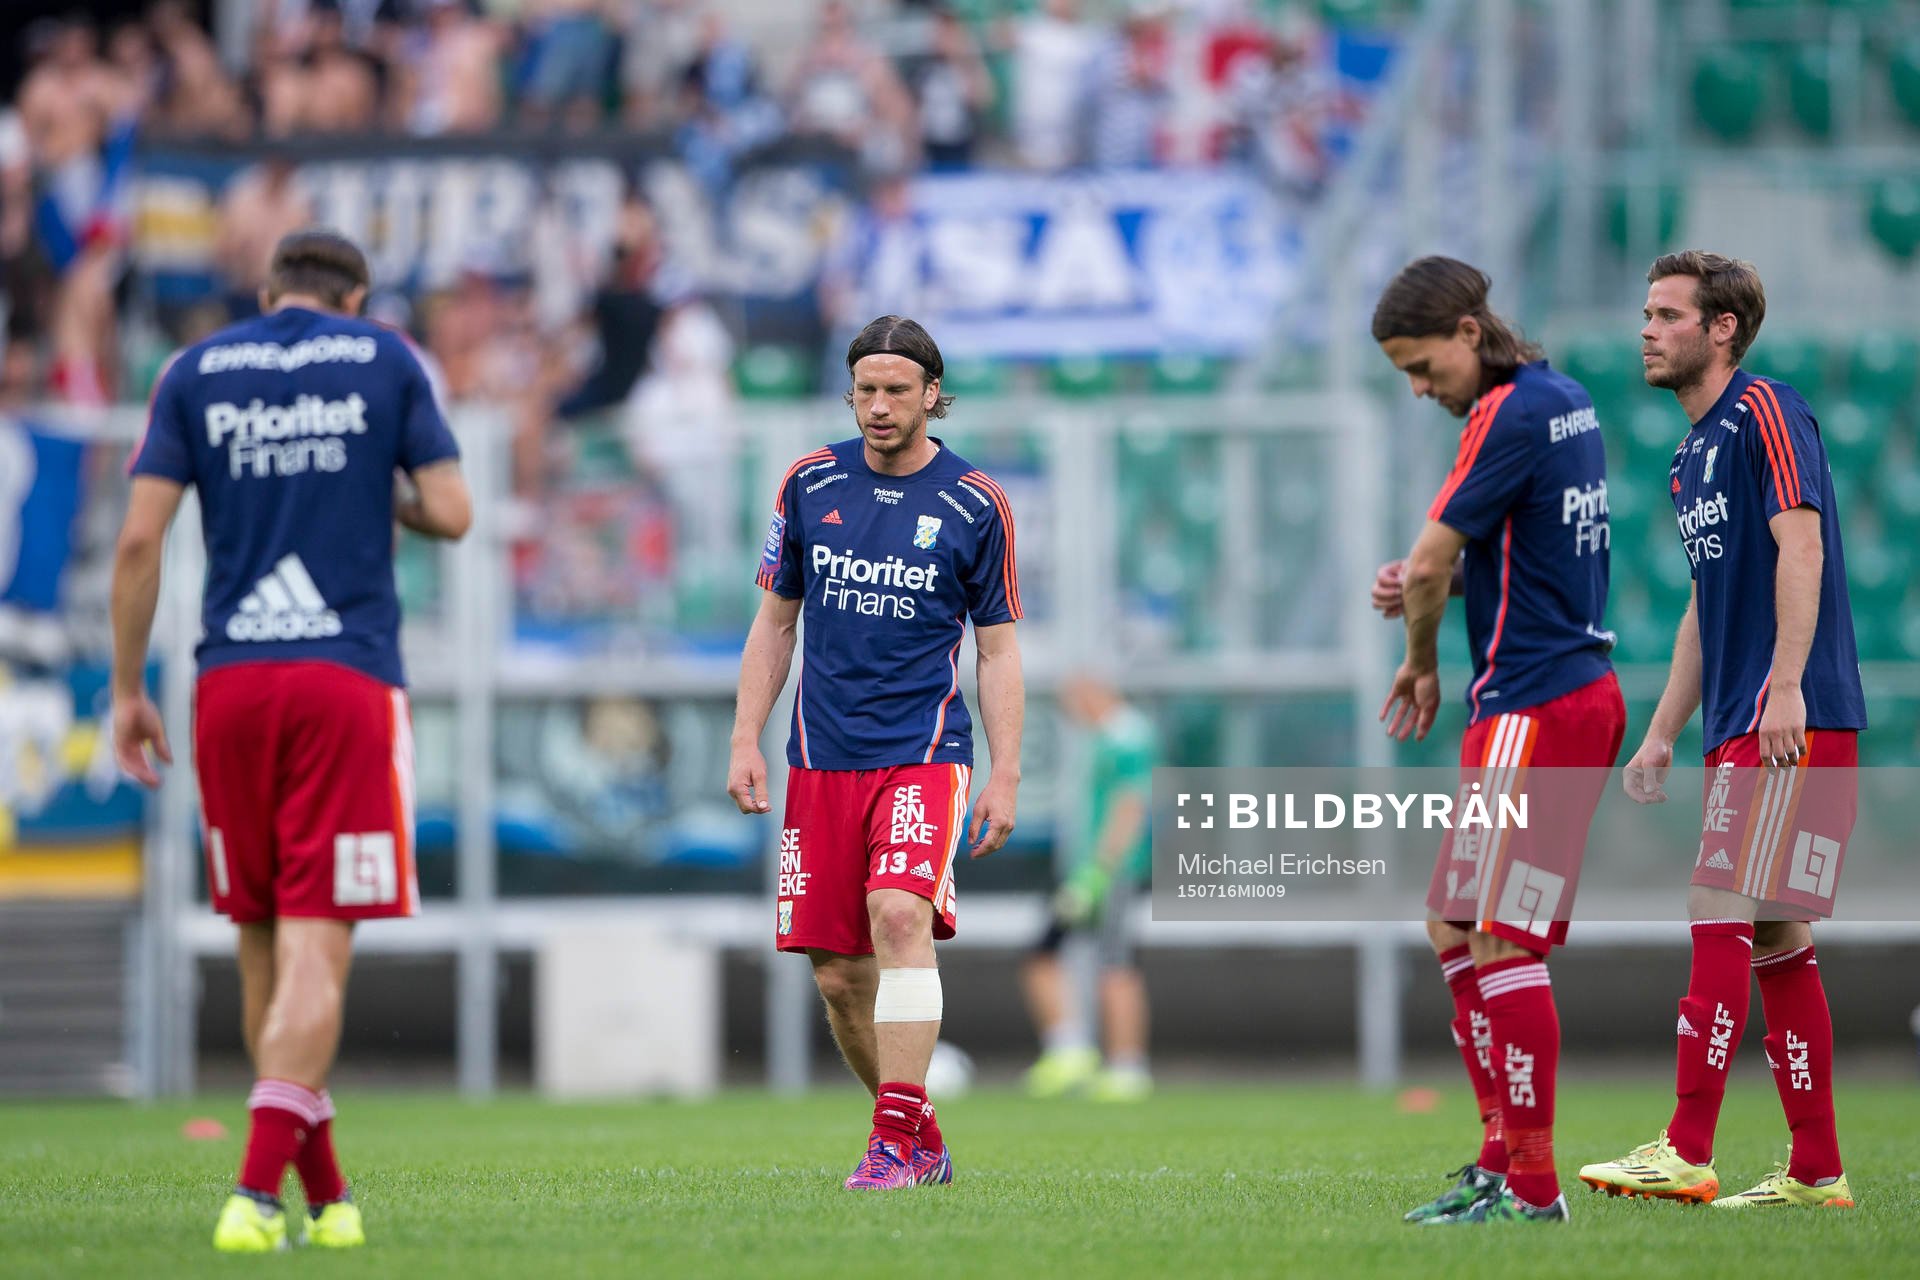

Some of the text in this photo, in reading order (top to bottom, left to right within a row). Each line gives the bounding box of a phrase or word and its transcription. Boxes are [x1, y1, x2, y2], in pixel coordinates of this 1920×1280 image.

[204, 392, 368, 448] Prioritet
[228, 437, 347, 480] Finans
[806, 473, 848, 494] EHRENBORG
[873, 488, 904, 499] Prioritet
[876, 495, 899, 505] Finans
[938, 490, 975, 524] EHRENBORG
[812, 544, 939, 593] Prioritet
[823, 577, 916, 620] Finans
[225, 609, 344, 642] adidas
[877, 852, 908, 876] 13
[910, 868, 936, 882] adidas
[1706, 860, 1734, 871] adidas
[1707, 1002, 1735, 1071] SKF
[1505, 1043, 1536, 1108] SKF
[1786, 1030, 1812, 1091] SKF
